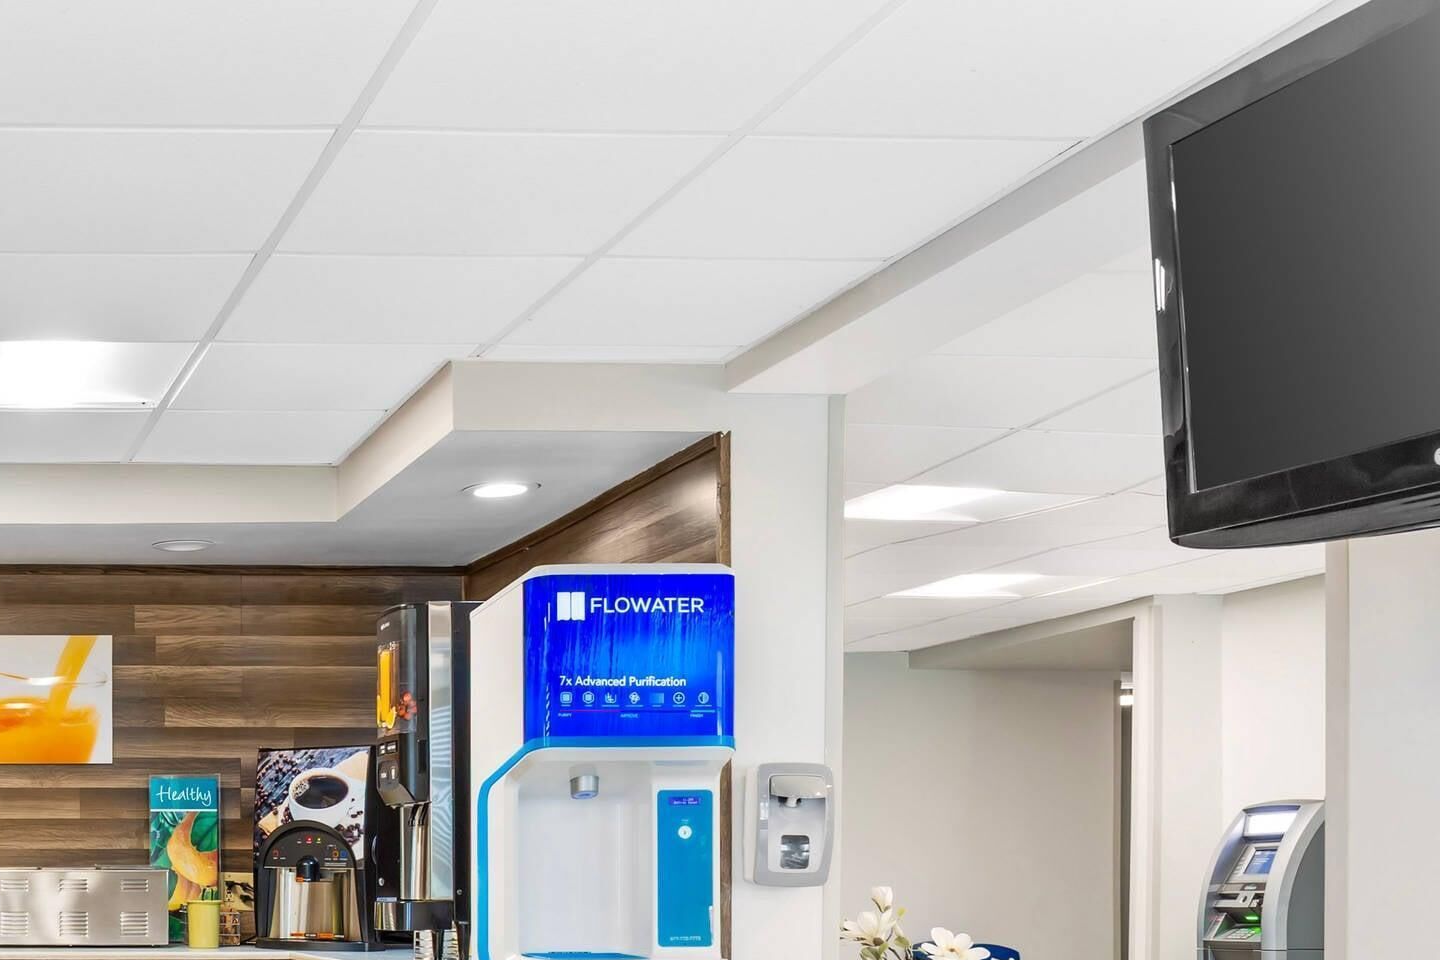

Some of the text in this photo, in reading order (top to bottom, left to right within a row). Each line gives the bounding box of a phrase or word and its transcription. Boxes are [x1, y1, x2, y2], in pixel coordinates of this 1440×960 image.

[590, 597, 705, 614] FLOWATER
[559, 675, 687, 687] 7x Advanced Purification
[155, 785, 212, 807] Healthy
